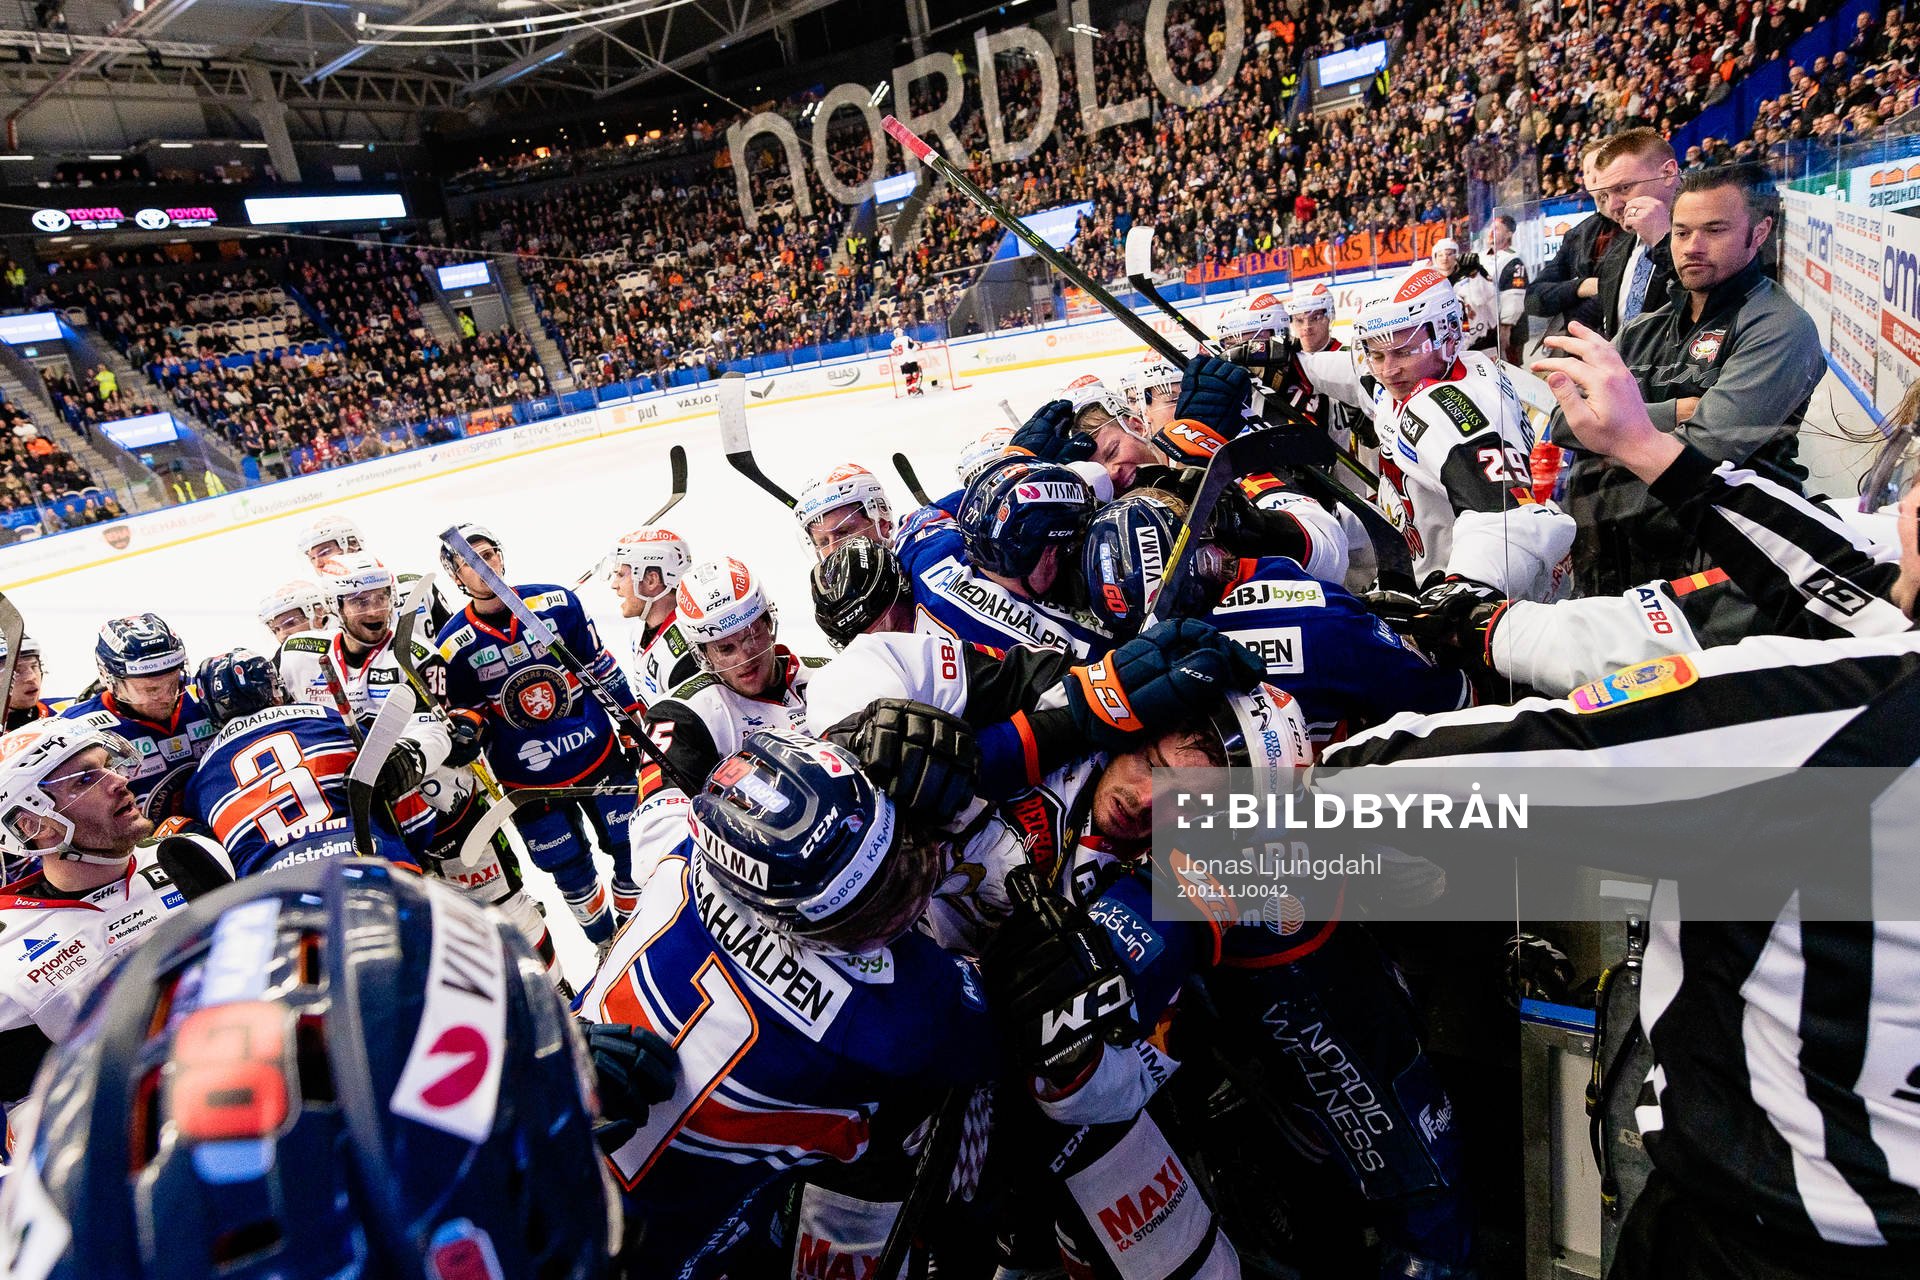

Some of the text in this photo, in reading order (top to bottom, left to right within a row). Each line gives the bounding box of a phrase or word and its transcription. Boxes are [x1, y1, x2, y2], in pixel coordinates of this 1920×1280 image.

[66, 207, 125, 220] TOYOTA
[165, 207, 217, 219] TOYOTA
[1367, 318, 1382, 327] OTTO
[1367, 315, 1411, 332] MAGNUSSON
[827, 367, 855, 381] ELIAS
[638, 404, 659, 422] put
[1442, 385, 1482, 426] GRÖNSAKS
[1442, 397, 1467, 425] HUSET
[513, 425, 551, 439] ACTIVE
[1383, 424, 1396, 434] CCM
[438, 436, 504, 459] INTERSPORT
[1478, 447, 1532, 485] 29
[1044, 483, 1083, 501] VISMA
[964, 507, 980, 525] 27
[1048, 529, 1074, 537] CCM
[1140, 528, 1162, 584] VISMA
[546, 593, 565, 607] put
[705, 596, 731, 612] CCM
[1220, 584, 1321, 609] GBJ bygg.
[719, 613, 737, 626] OTTO
[721, 605, 760, 631] MAGNUSSON
[836, 604, 864, 627] CCM
[1635, 587, 1673, 634] AT80
[454, 630, 473, 647] put
[474, 620, 491, 633] CCM
[140, 637, 164, 648] CCM
[138, 663, 158, 672] OBOS
[425, 665, 447, 696] 36
[514, 669, 542, 688] LAKERS
[542, 669, 567, 695] HOCKEY
[89, 712, 113, 728] put
[219, 705, 321, 744] MEDIAHJÄLPEN
[546, 725, 597, 758] VIDA
[1269, 730, 1282, 758] OTTO
[1287, 716, 1304, 758] CCM
[230, 730, 334, 844] 3
[800, 805, 840, 859] CCM
[703, 828, 764, 888] VISMA
[451, 862, 500, 888] MAXI
[829, 869, 864, 906] OBOS
[92, 884, 120, 903] SHL
[166, 894, 184, 906] EHR
[107, 908, 144, 932] CCM
[115, 914, 158, 940] MonkeySports
[1112, 905, 1152, 943] DATA
[26, 938, 87, 984] Prioritet
[45, 952, 87, 987] Finans
[1262, 1003, 1385, 1172] WELLNESS
[1300, 1021, 1393, 1135] NORDIC
[1049, 1125, 1090, 1174] CCM
[1097, 1154, 1184, 1242] MAXI
[1117, 1180, 1189, 1253] ICA STORMARKNAD
